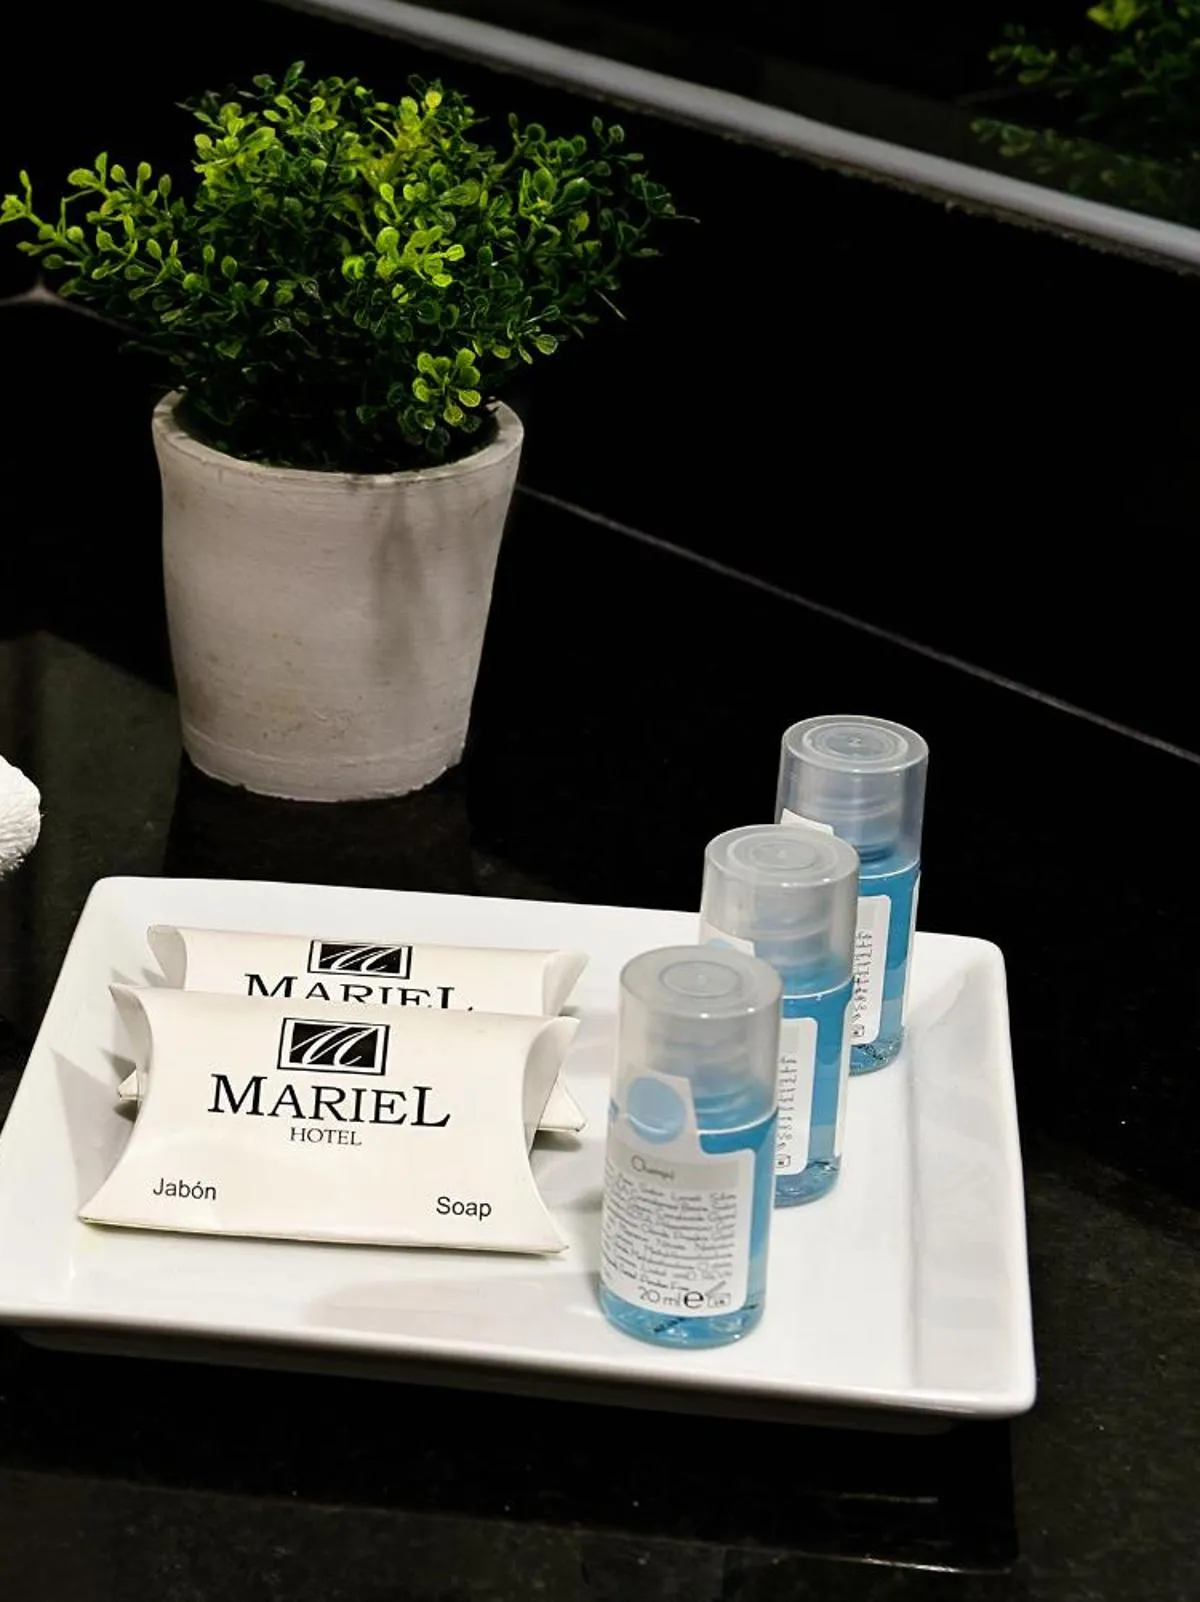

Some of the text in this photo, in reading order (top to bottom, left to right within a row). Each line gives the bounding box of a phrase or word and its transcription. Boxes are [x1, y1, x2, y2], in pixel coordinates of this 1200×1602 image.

[206, 1072, 452, 1129] MARIEL
[289, 1126, 363, 1147] HOTEL
[152, 1176, 218, 1201] Jabón
[435, 1195, 493, 1222] Soap
